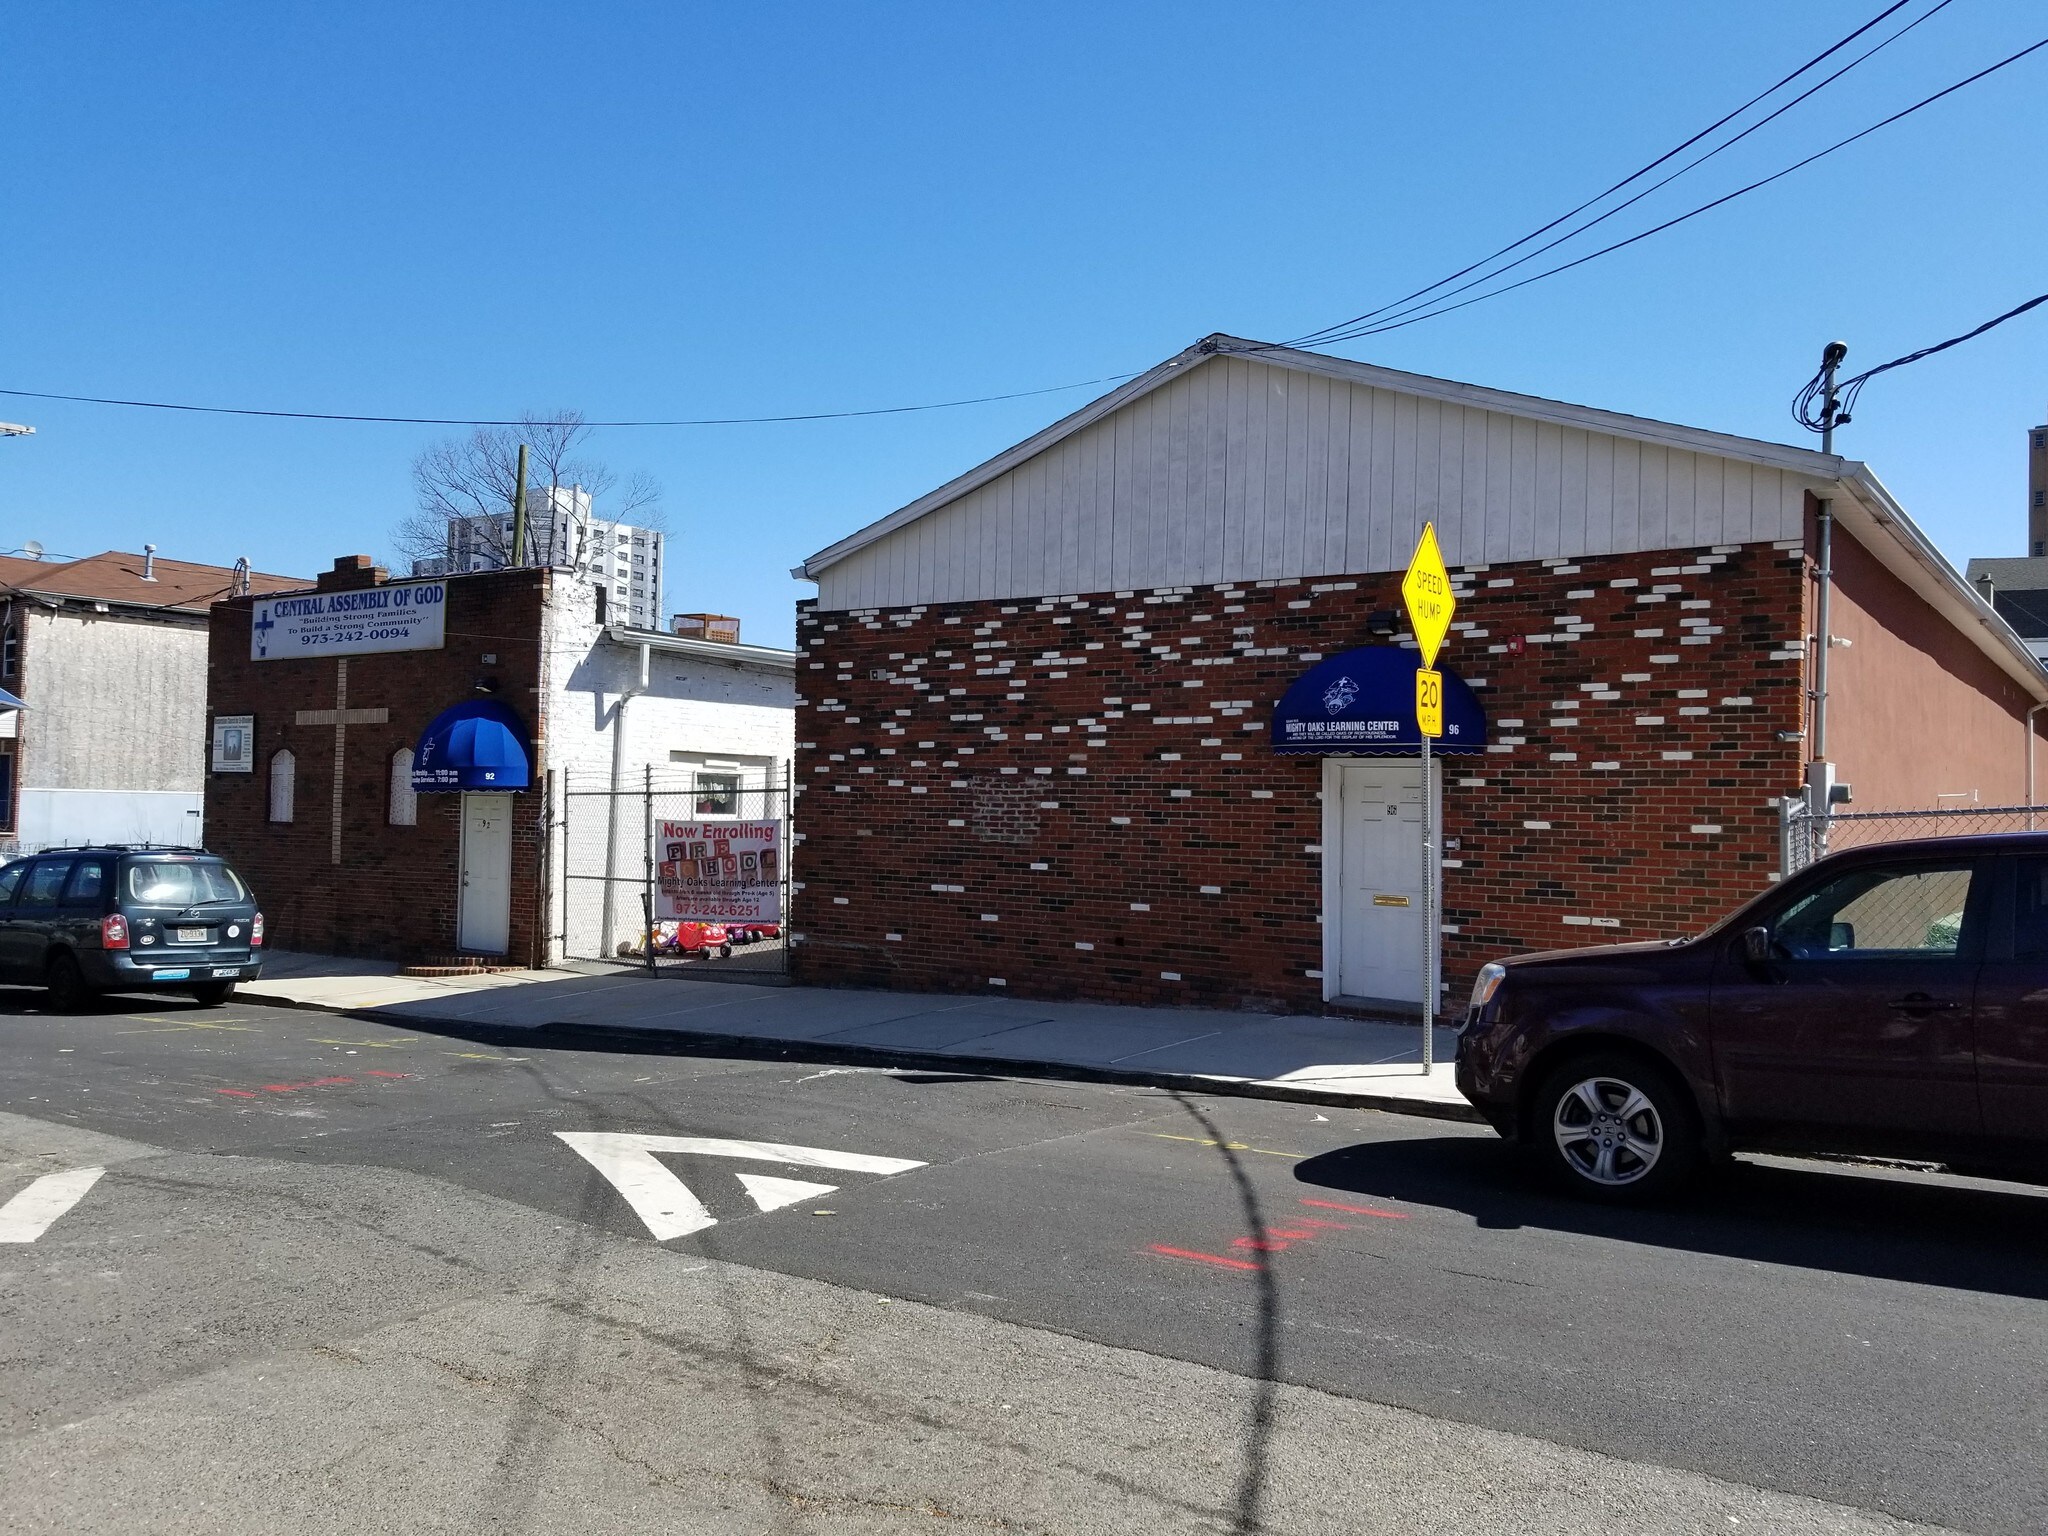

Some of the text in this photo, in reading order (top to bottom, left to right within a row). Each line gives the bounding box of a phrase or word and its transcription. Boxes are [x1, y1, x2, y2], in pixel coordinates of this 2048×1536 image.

[1416, 569, 1442, 596] SPEED
[274, 585, 444, 618] CENTRAL ASSEMBLY OF GOD
[342, 612, 374, 622] Strong
[377, 608, 417, 618] Families
[1417, 598, 1442, 622] HUMP
[300, 625, 322, 634] Build
[334, 621, 364, 631] Strong
[301, 628, 410, 646] 973-242-0094
[1420, 680, 1438, 708] 20
[1286, 720, 1400, 732] MIGHTY OAKS LEARNING CENTER
[1448, 724, 1460, 735] 96
[1386, 804, 1398, 816] 96
[482, 820, 490, 829] 92
[663, 822, 774, 842] Now Enrolling
[658, 876, 778, 889] Mighty Oaks Learning Center
[676, 904, 760, 916] 973-242-6251
